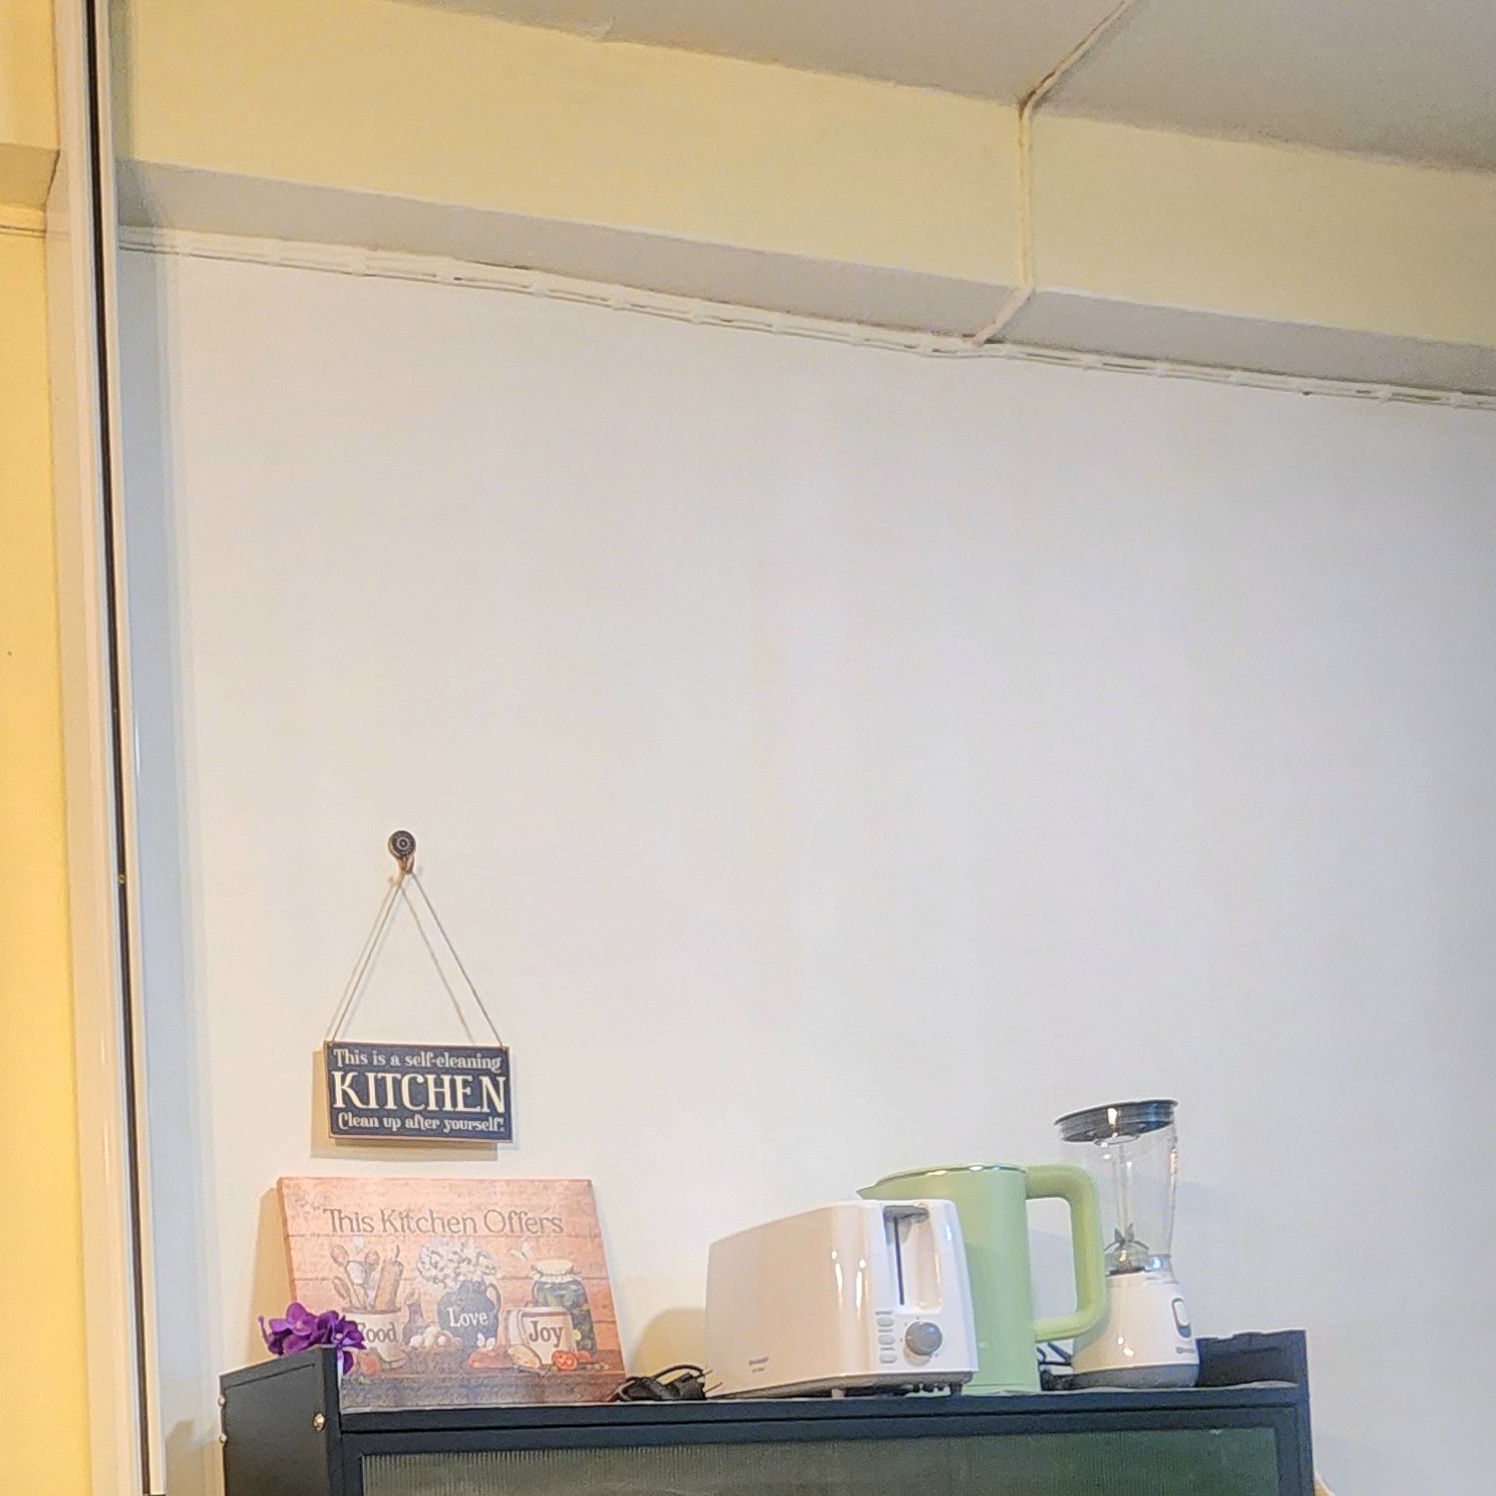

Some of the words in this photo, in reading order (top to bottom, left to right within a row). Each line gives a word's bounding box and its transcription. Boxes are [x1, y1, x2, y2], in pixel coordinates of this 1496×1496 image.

[333, 1049, 368, 1067] This
[372, 1052, 386, 1066] is
[390, 1055, 402, 1066] a
[405, 1051, 502, 1073] self-cleaning
[332, 1071, 506, 1113] KITCHEN
[338, 1112, 379, 1130] Clean
[383, 1117, 401, 1131] up
[405, 1116, 440, 1130] after
[443, 1115, 505, 1133] yourself!
[323, 1208, 375, 1233] This
[381, 1208, 478, 1234] Kitchen
[484, 1209, 564, 1234] Offers
[447, 1308, 490, 1328] Love
[528, 1320, 565, 1346] Joy
